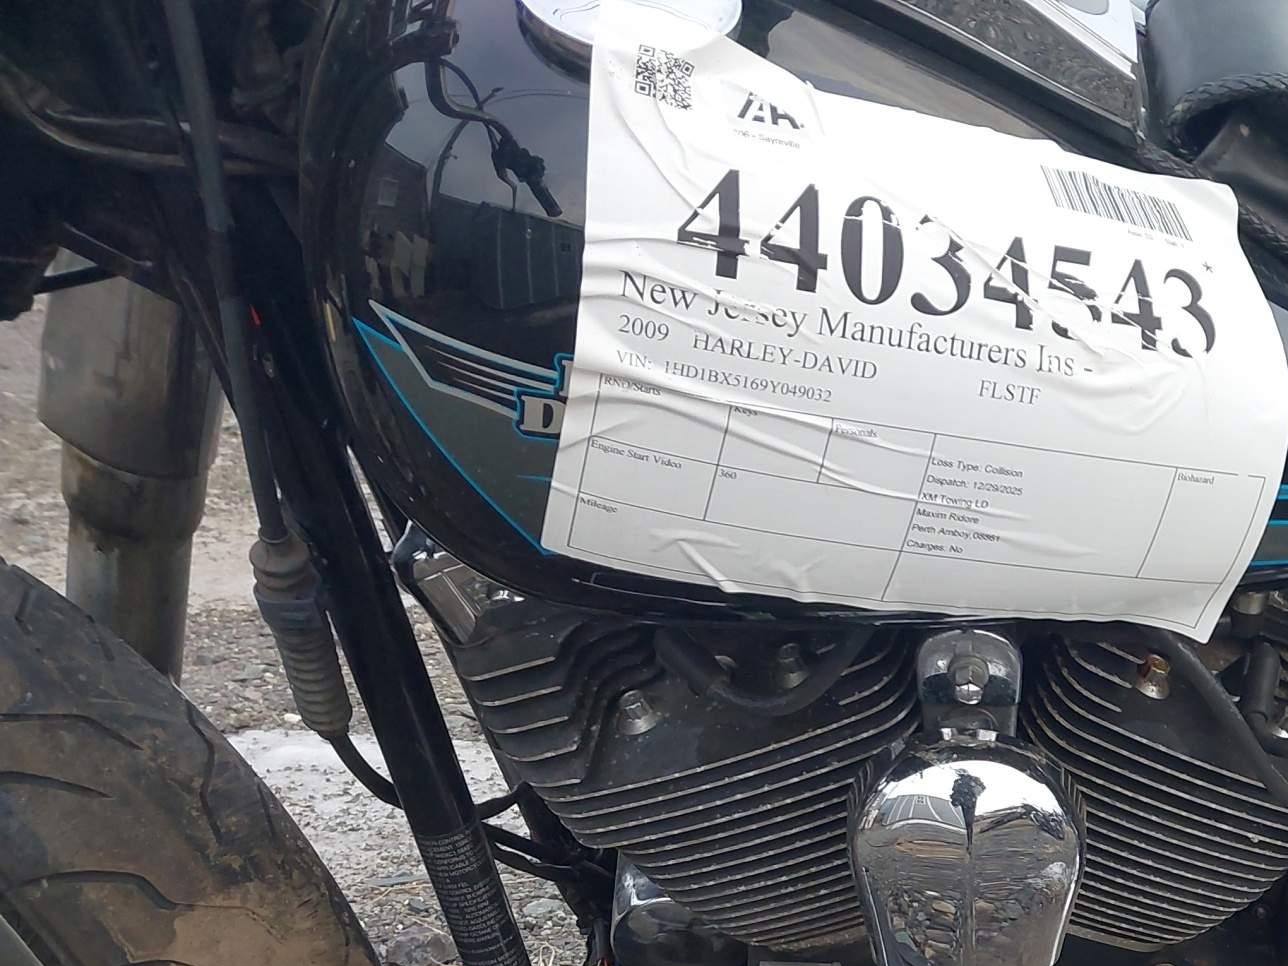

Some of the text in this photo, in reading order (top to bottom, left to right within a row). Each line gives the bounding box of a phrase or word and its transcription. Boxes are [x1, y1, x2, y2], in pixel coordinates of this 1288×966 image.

[677, 168, 1216, 359] 44034543
[619, 270, 699, 311] New
[708, 289, 808, 337] Jersey
[816, 306, 1027, 369] Manufacturers
[1036, 344, 1075, 377] Ins
[618, 314, 877, 380] 2009 HARLEY-DAVID
[616, 350, 832, 403] VIN: 1HD1BX5169Y049032
[979, 379, 1041, 405] FLSTF
[591, 440, 682, 470] Engine Start Video
[931, 457, 954, 468] Loss
[984, 464, 1023, 478] Collision
[719, 469, 737, 480] 360
[580, 496, 618, 514] Mileage
[940, 494, 973, 510] Towing
[949, 544, 964, 553] No
